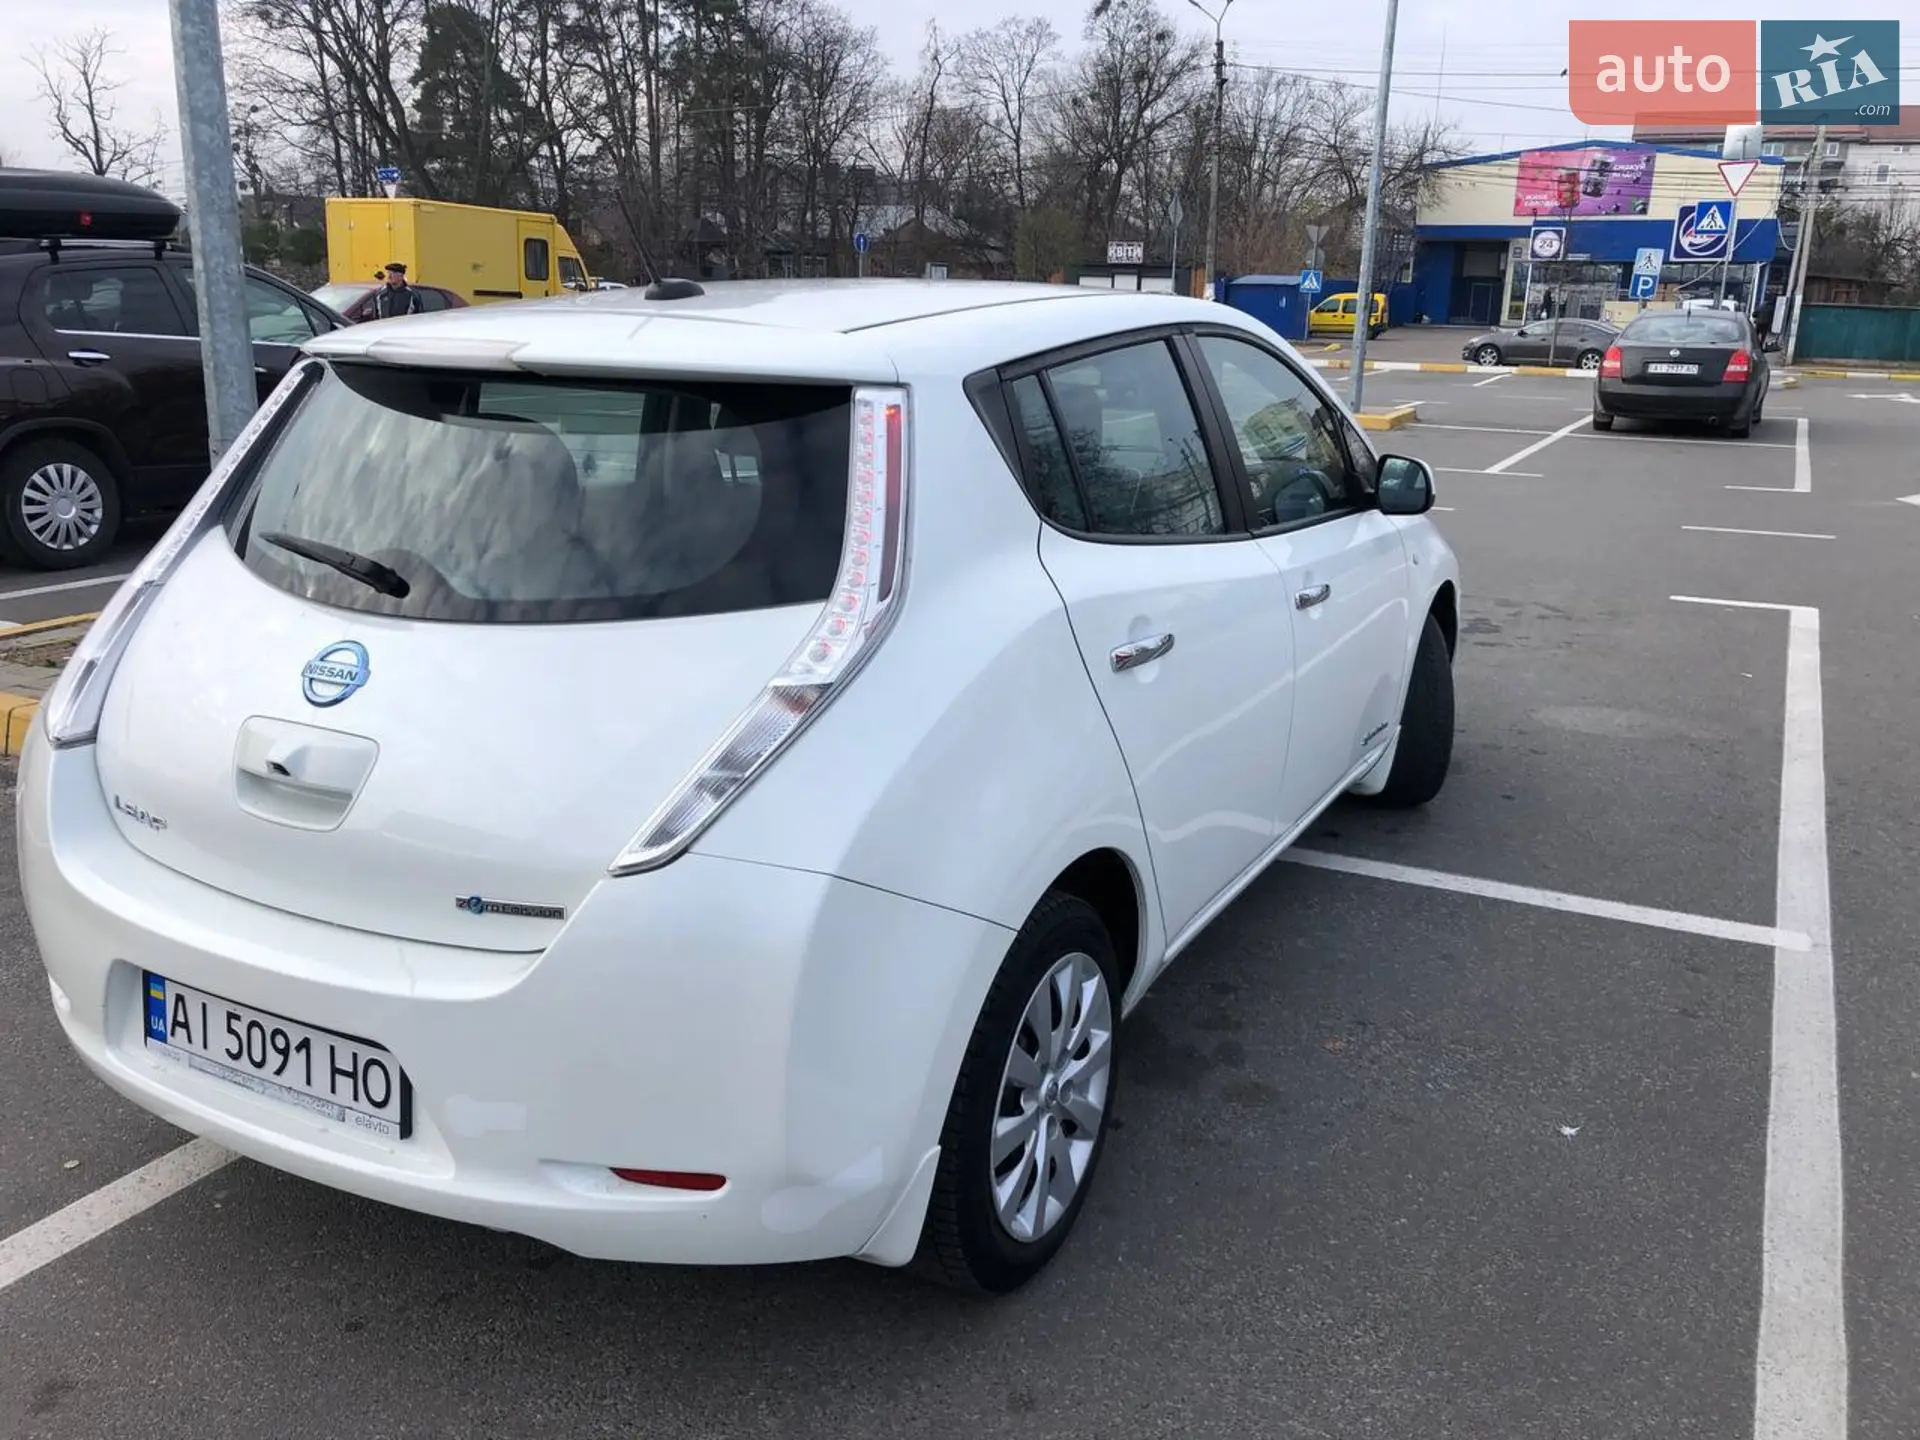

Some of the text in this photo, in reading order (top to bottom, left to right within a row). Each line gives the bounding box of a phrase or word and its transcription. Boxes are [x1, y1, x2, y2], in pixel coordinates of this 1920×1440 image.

[1539, 239, 1554, 249] 24
[1638, 277, 1653, 295] P
[306, 664, 358, 681] NISSAN
[151, 1015, 165, 1032] UA
[170, 993, 208, 1050] AI
[225, 1009, 312, 1087] 5091
[329, 1044, 391, 1109] HO
